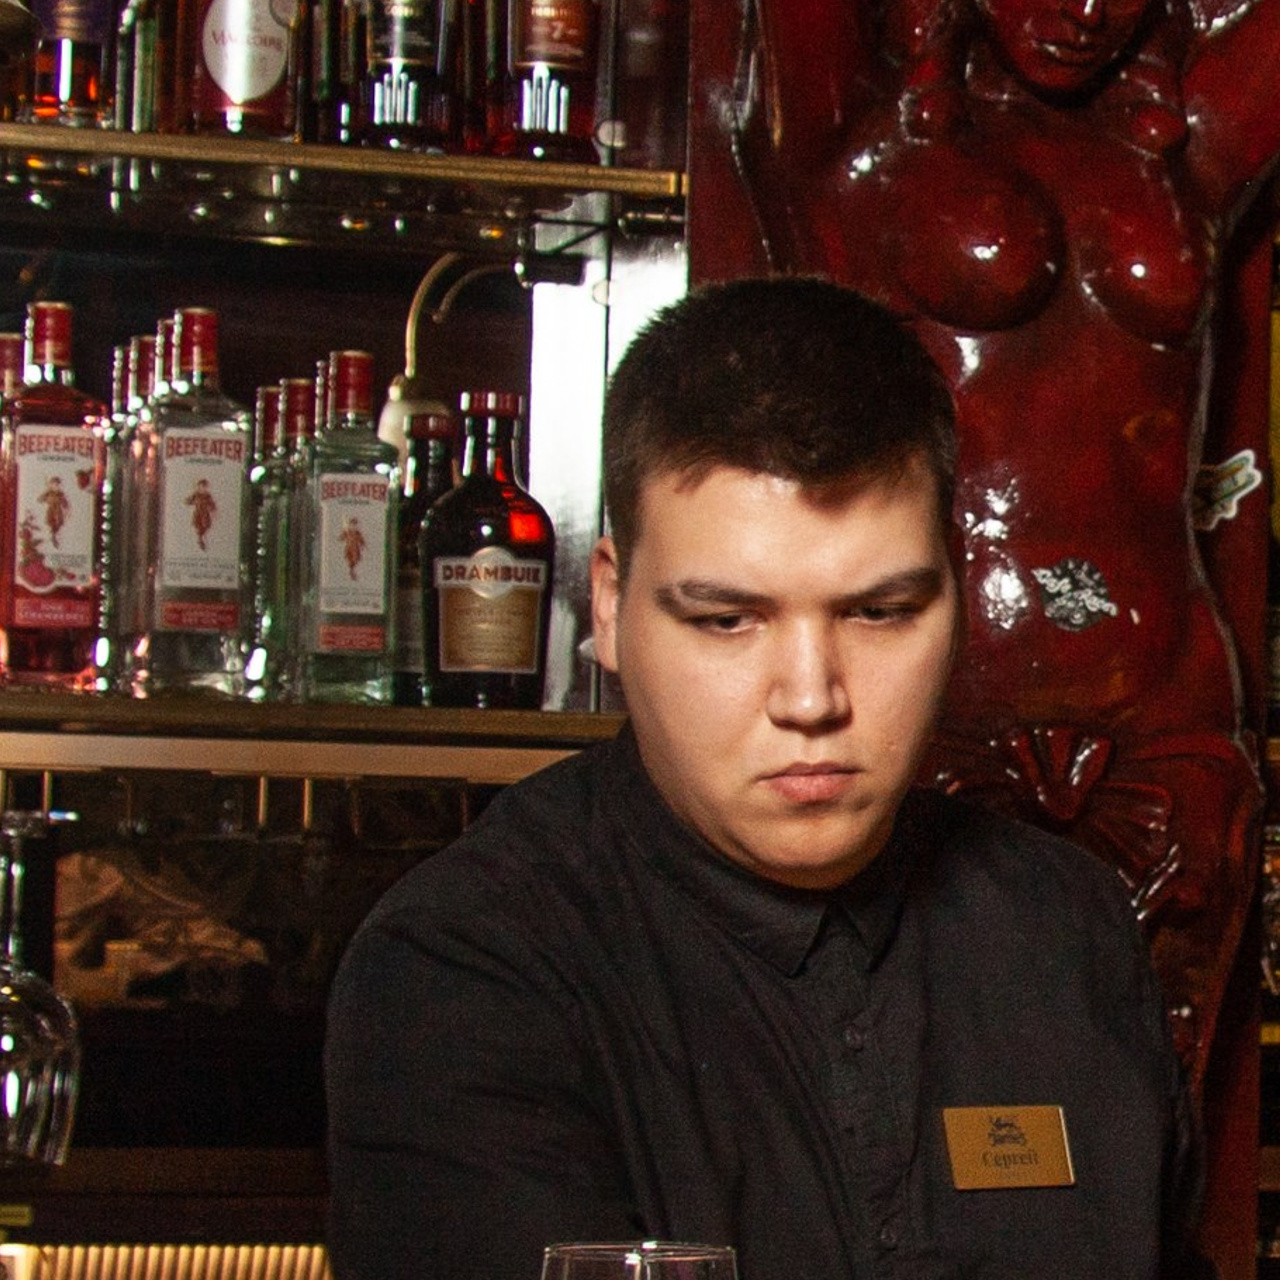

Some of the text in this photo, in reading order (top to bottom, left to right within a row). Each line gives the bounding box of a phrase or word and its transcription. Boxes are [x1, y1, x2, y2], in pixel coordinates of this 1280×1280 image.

[20, 433, 94, 459] BEEFEATER
[165, 435, 243, 462] BEEFEATER
[322, 480, 387, 503] BEEFEATER
[442, 564, 541, 583] DRAMBUIE
